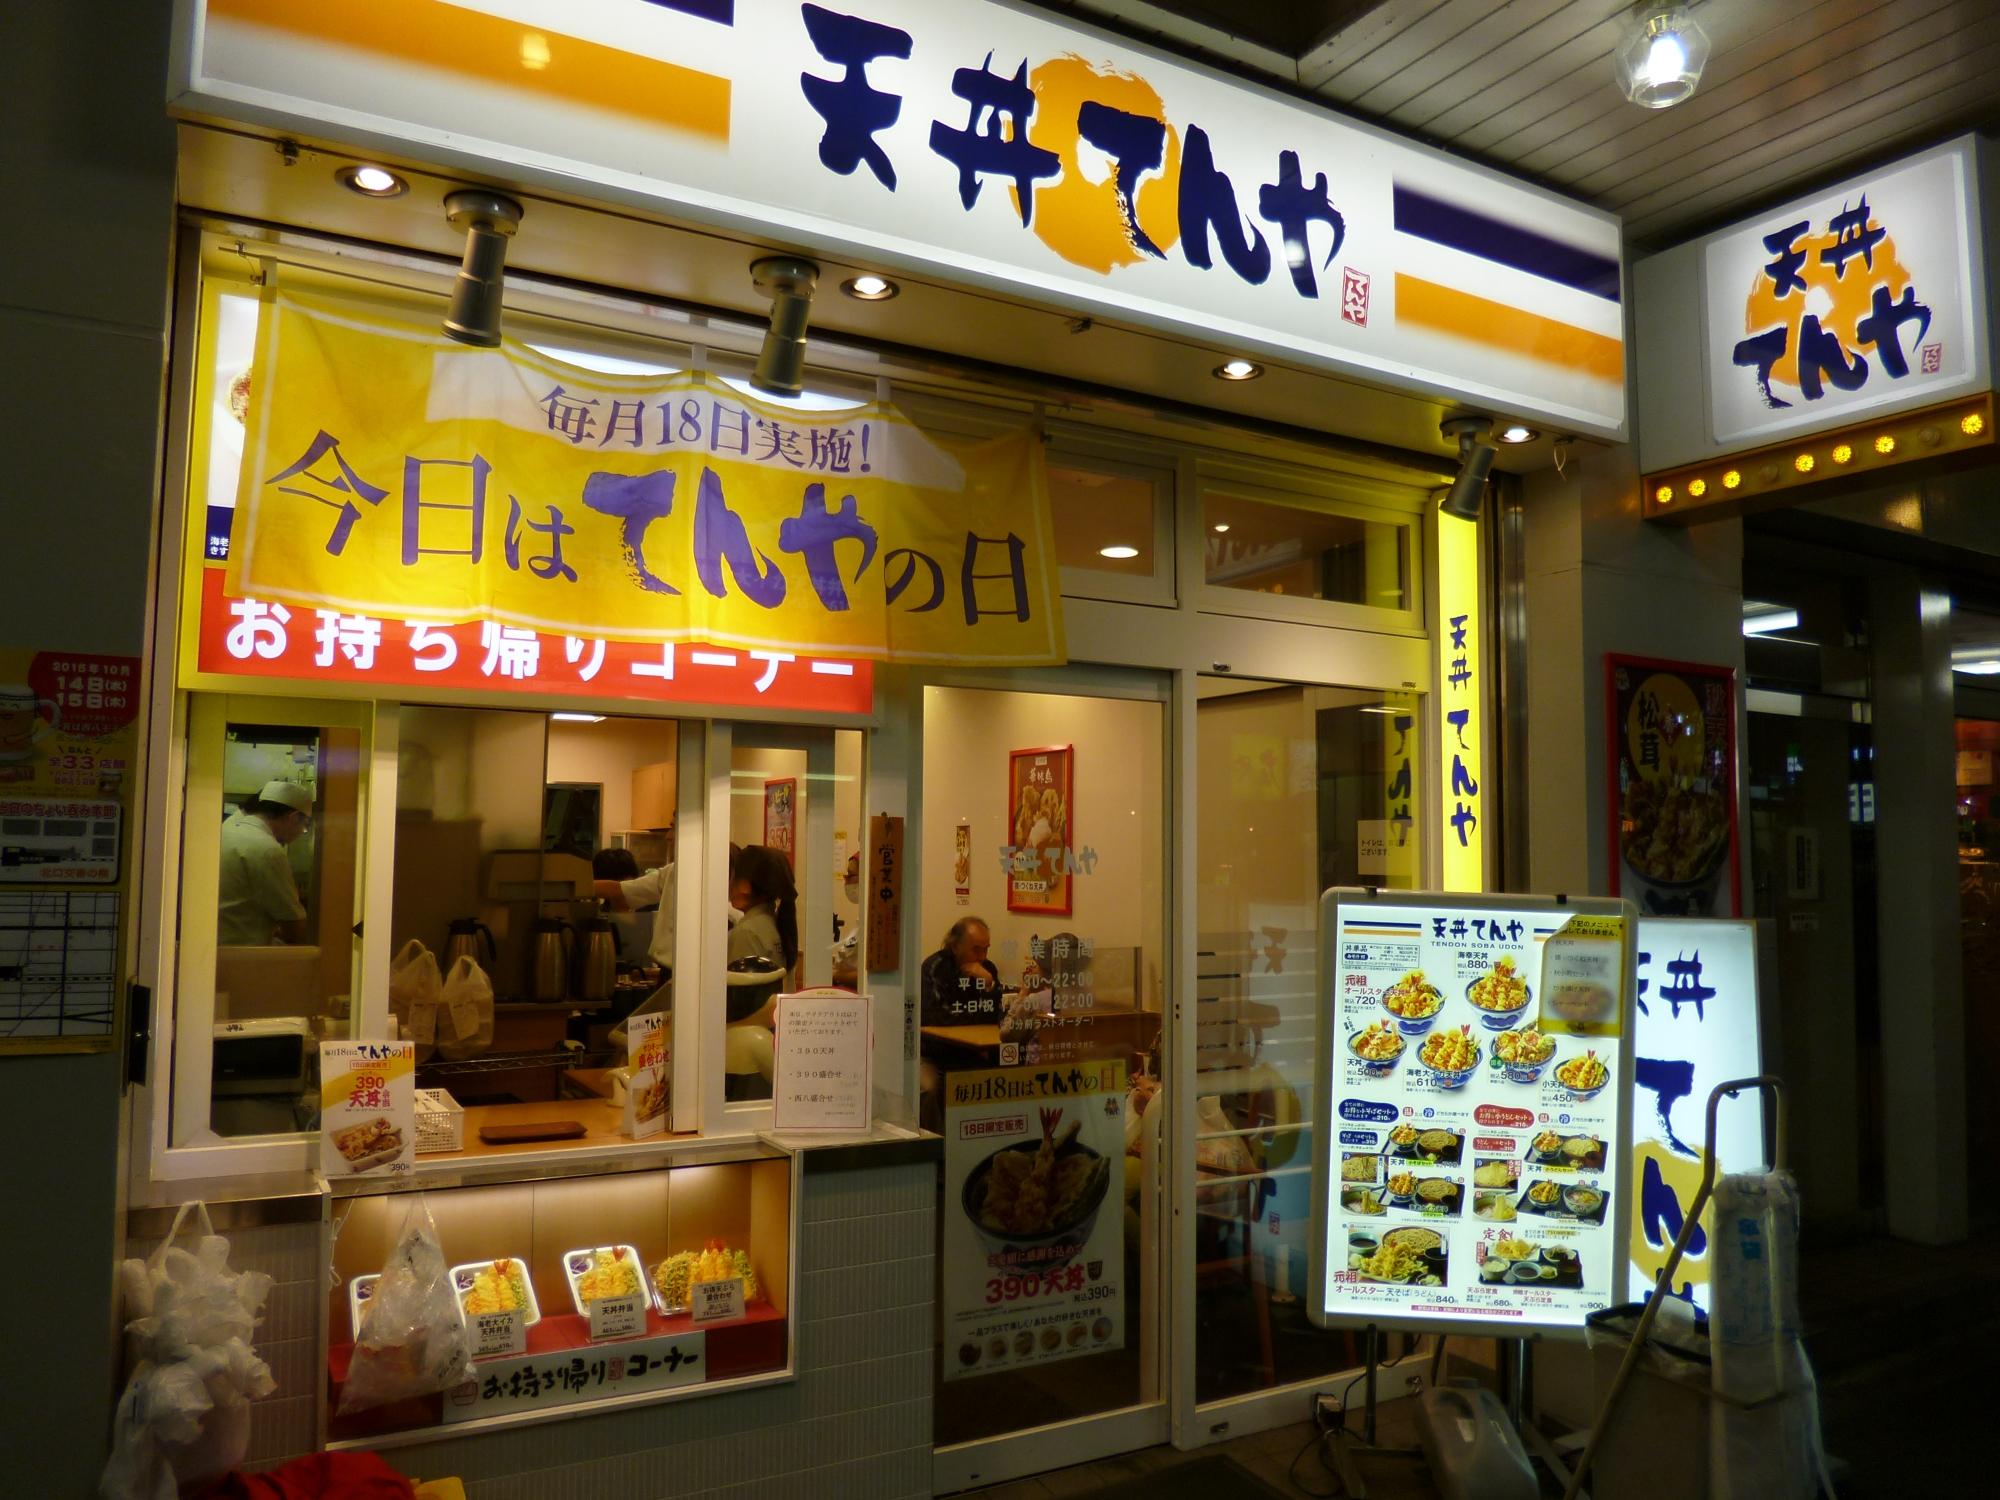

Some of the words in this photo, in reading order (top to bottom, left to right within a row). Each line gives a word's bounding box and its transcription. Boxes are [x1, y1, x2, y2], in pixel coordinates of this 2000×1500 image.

[1763, 192, 1886, 298] 天丼
[1733, 286, 1932, 409] てんや
[540, 384, 871, 474] 毎月18日実施!
[264, 429, 1031, 626] 今日はてんやの日
[1447, 615, 1478, 847] 天丼てんや
[878, 843, 895, 902] 営業中
[998, 845, 1098, 876] 天丼てんや
[1432, 917, 1524, 942] 天丼てんや
[958, 978, 986, 991] 平日
[1345, 975, 1367, 986] 元祖
[355, 1076, 384, 1089] 390
[955, 1066, 1117, 1102] 毎月18日はてんやの日
[1543, 1080, 1565, 1089] 小天丼
[1390, 1158, 1405, 1166] 天丼
[1334, 1271, 1357, 1283] 元祖
[627, 1345, 698, 1377] コーナー
